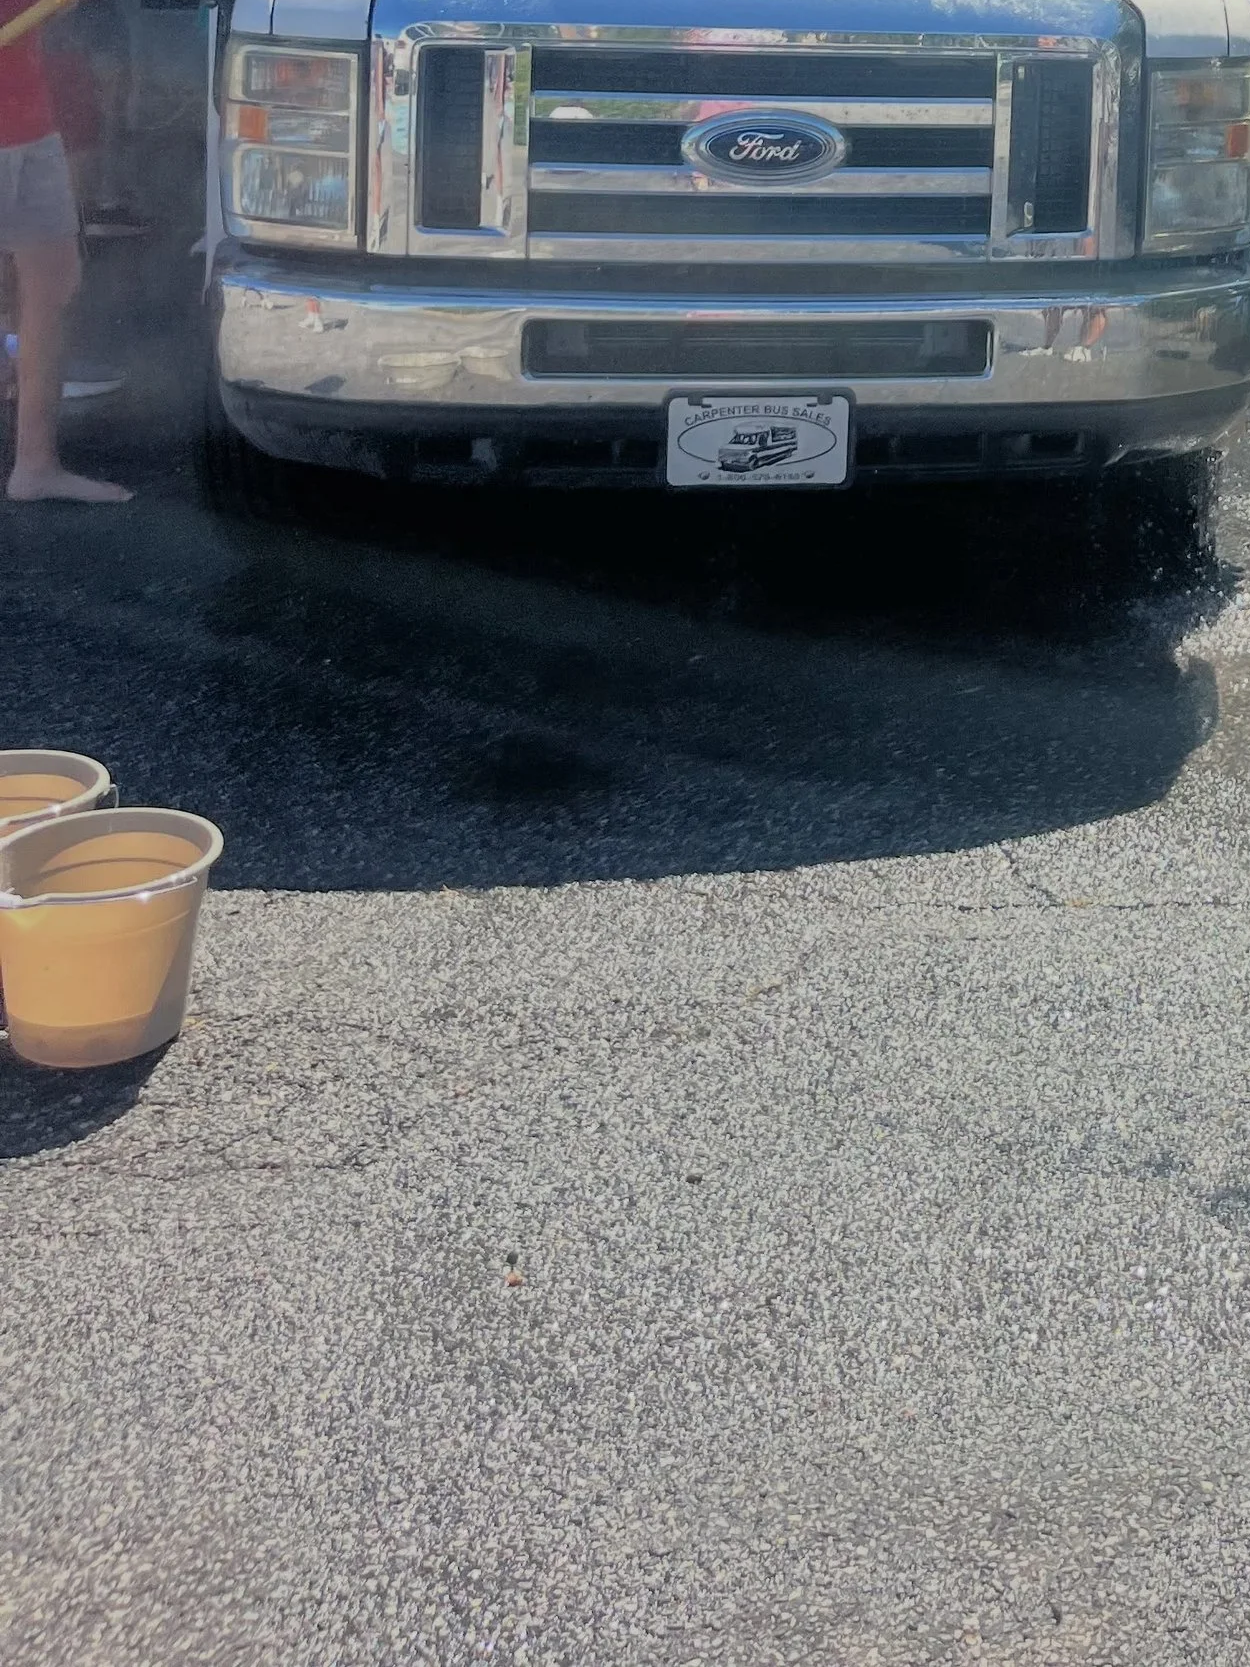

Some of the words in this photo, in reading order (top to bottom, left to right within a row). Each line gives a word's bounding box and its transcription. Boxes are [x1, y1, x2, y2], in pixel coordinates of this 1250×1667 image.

[729, 132, 802, 161] Ford
[684, 404, 760, 427] CARPENTER
[764, 405, 788, 416] BUS
[792, 407, 832, 426] SALES
